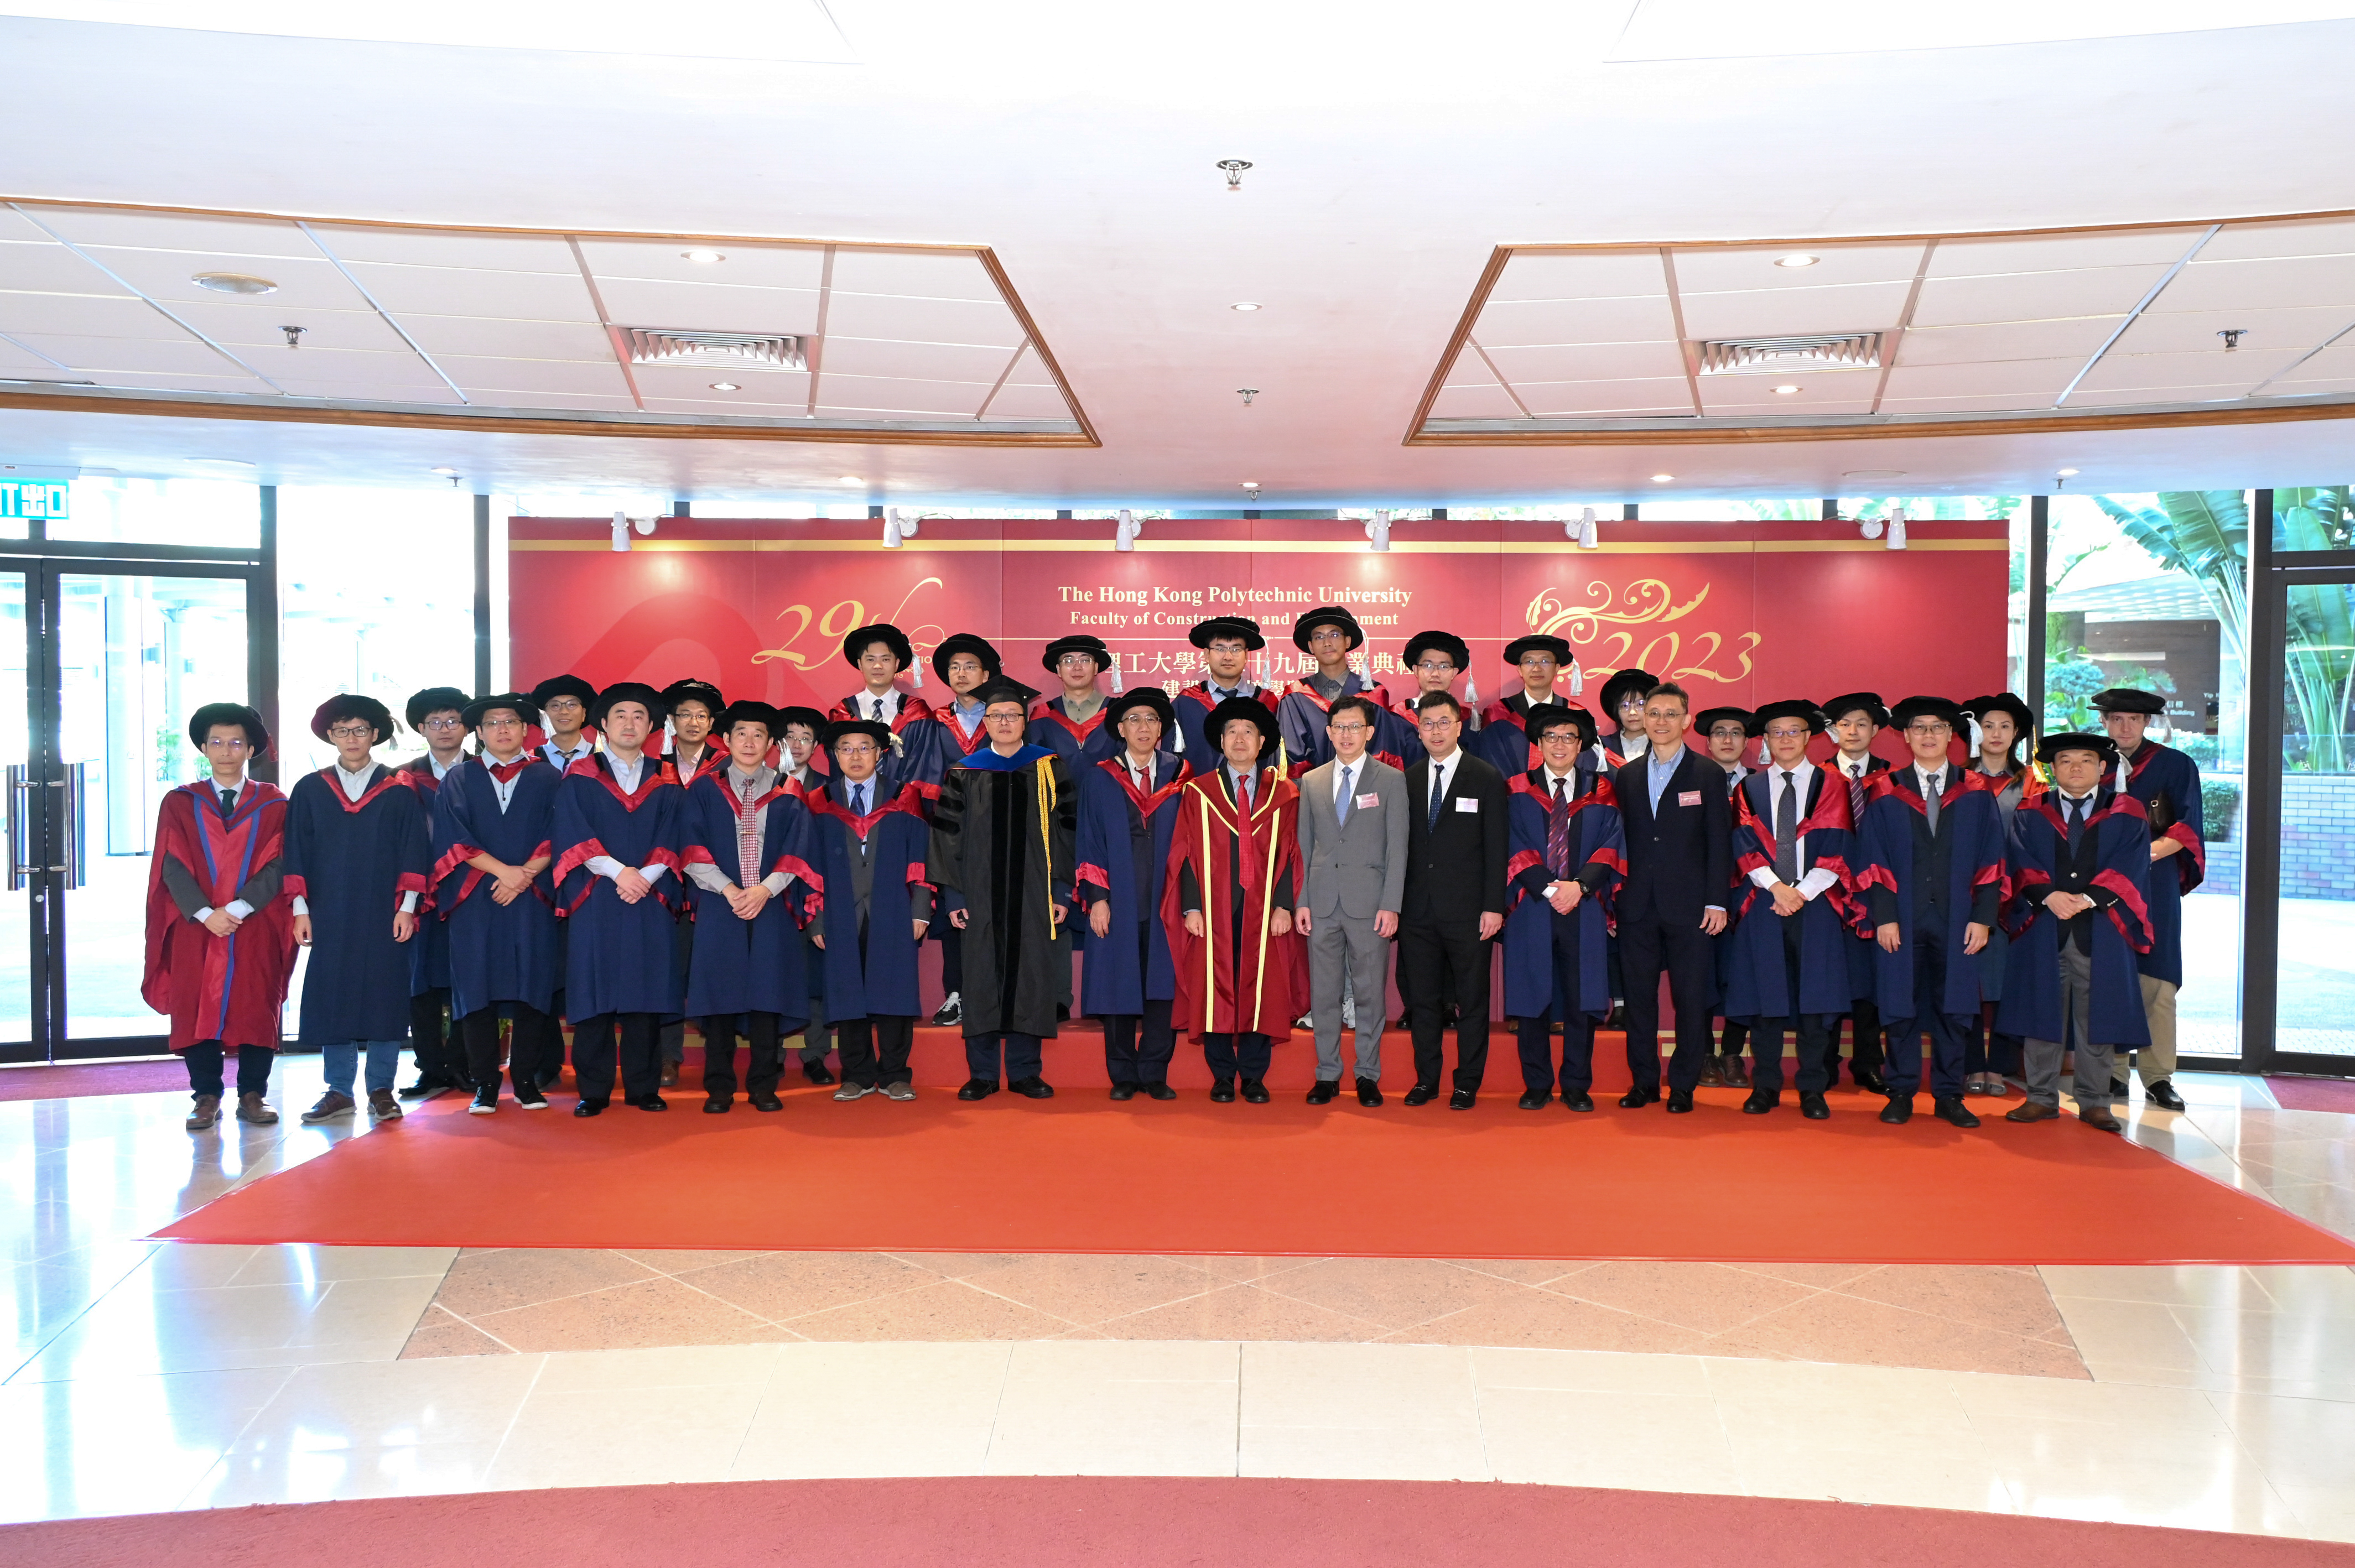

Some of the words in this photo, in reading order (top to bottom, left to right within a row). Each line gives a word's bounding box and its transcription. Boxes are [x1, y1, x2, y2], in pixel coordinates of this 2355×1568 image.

[21, 484, 67, 517] 出口
[1058, 586, 1093, 602] The
[1099, 586, 1148, 606] Hong
[1153, 586, 1203, 606] Kong
[1208, 586, 1312, 606] Polytechnic
[1318, 587, 1412, 607] University
[1070, 612, 1128, 628] Faculty
[1134, 612, 1150, 624] of
[1261, 612, 1290, 625] and
[1583, 632, 1761, 683] 2023
